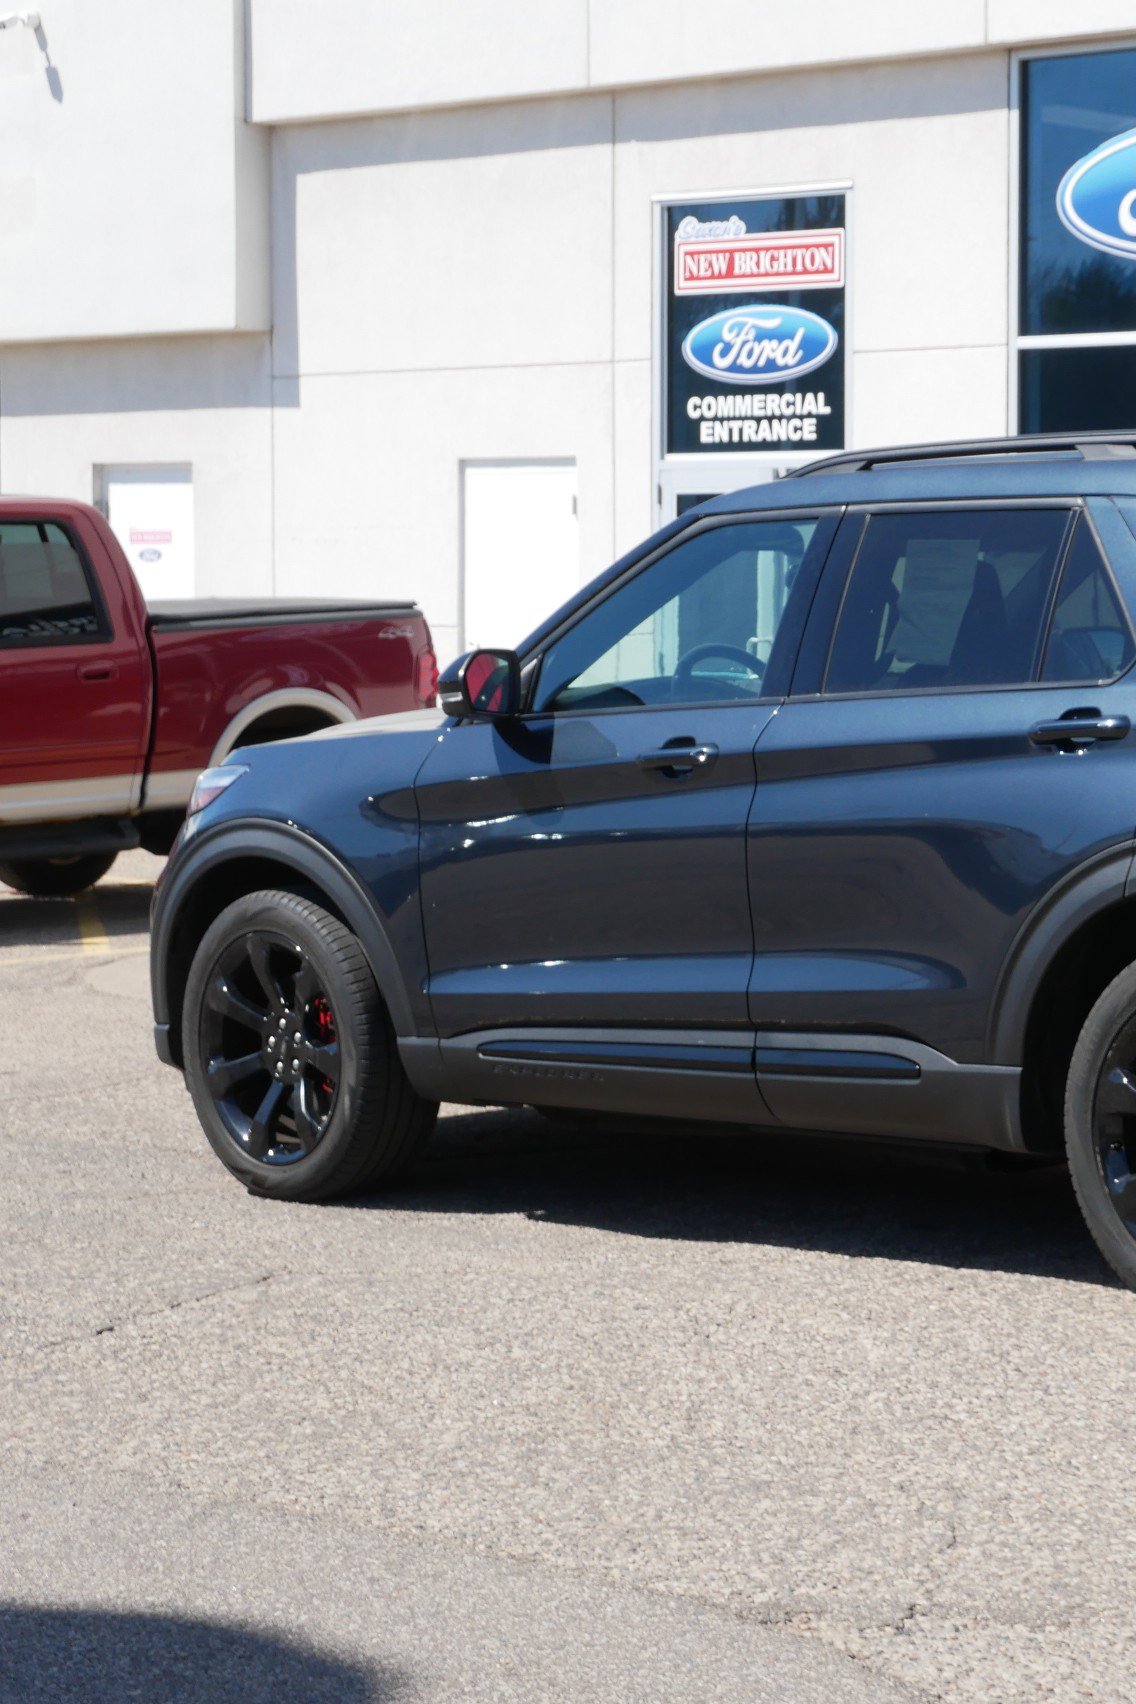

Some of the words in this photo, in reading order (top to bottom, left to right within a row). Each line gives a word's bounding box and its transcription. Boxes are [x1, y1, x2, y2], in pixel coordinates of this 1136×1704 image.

[684, 252, 730, 279] NEW
[734, 246, 834, 275] BRIGHTON
[712, 316, 804, 369] Ford
[687, 392, 831, 419] COMMERCIAL
[700, 418, 817, 443] ENTRANCE
